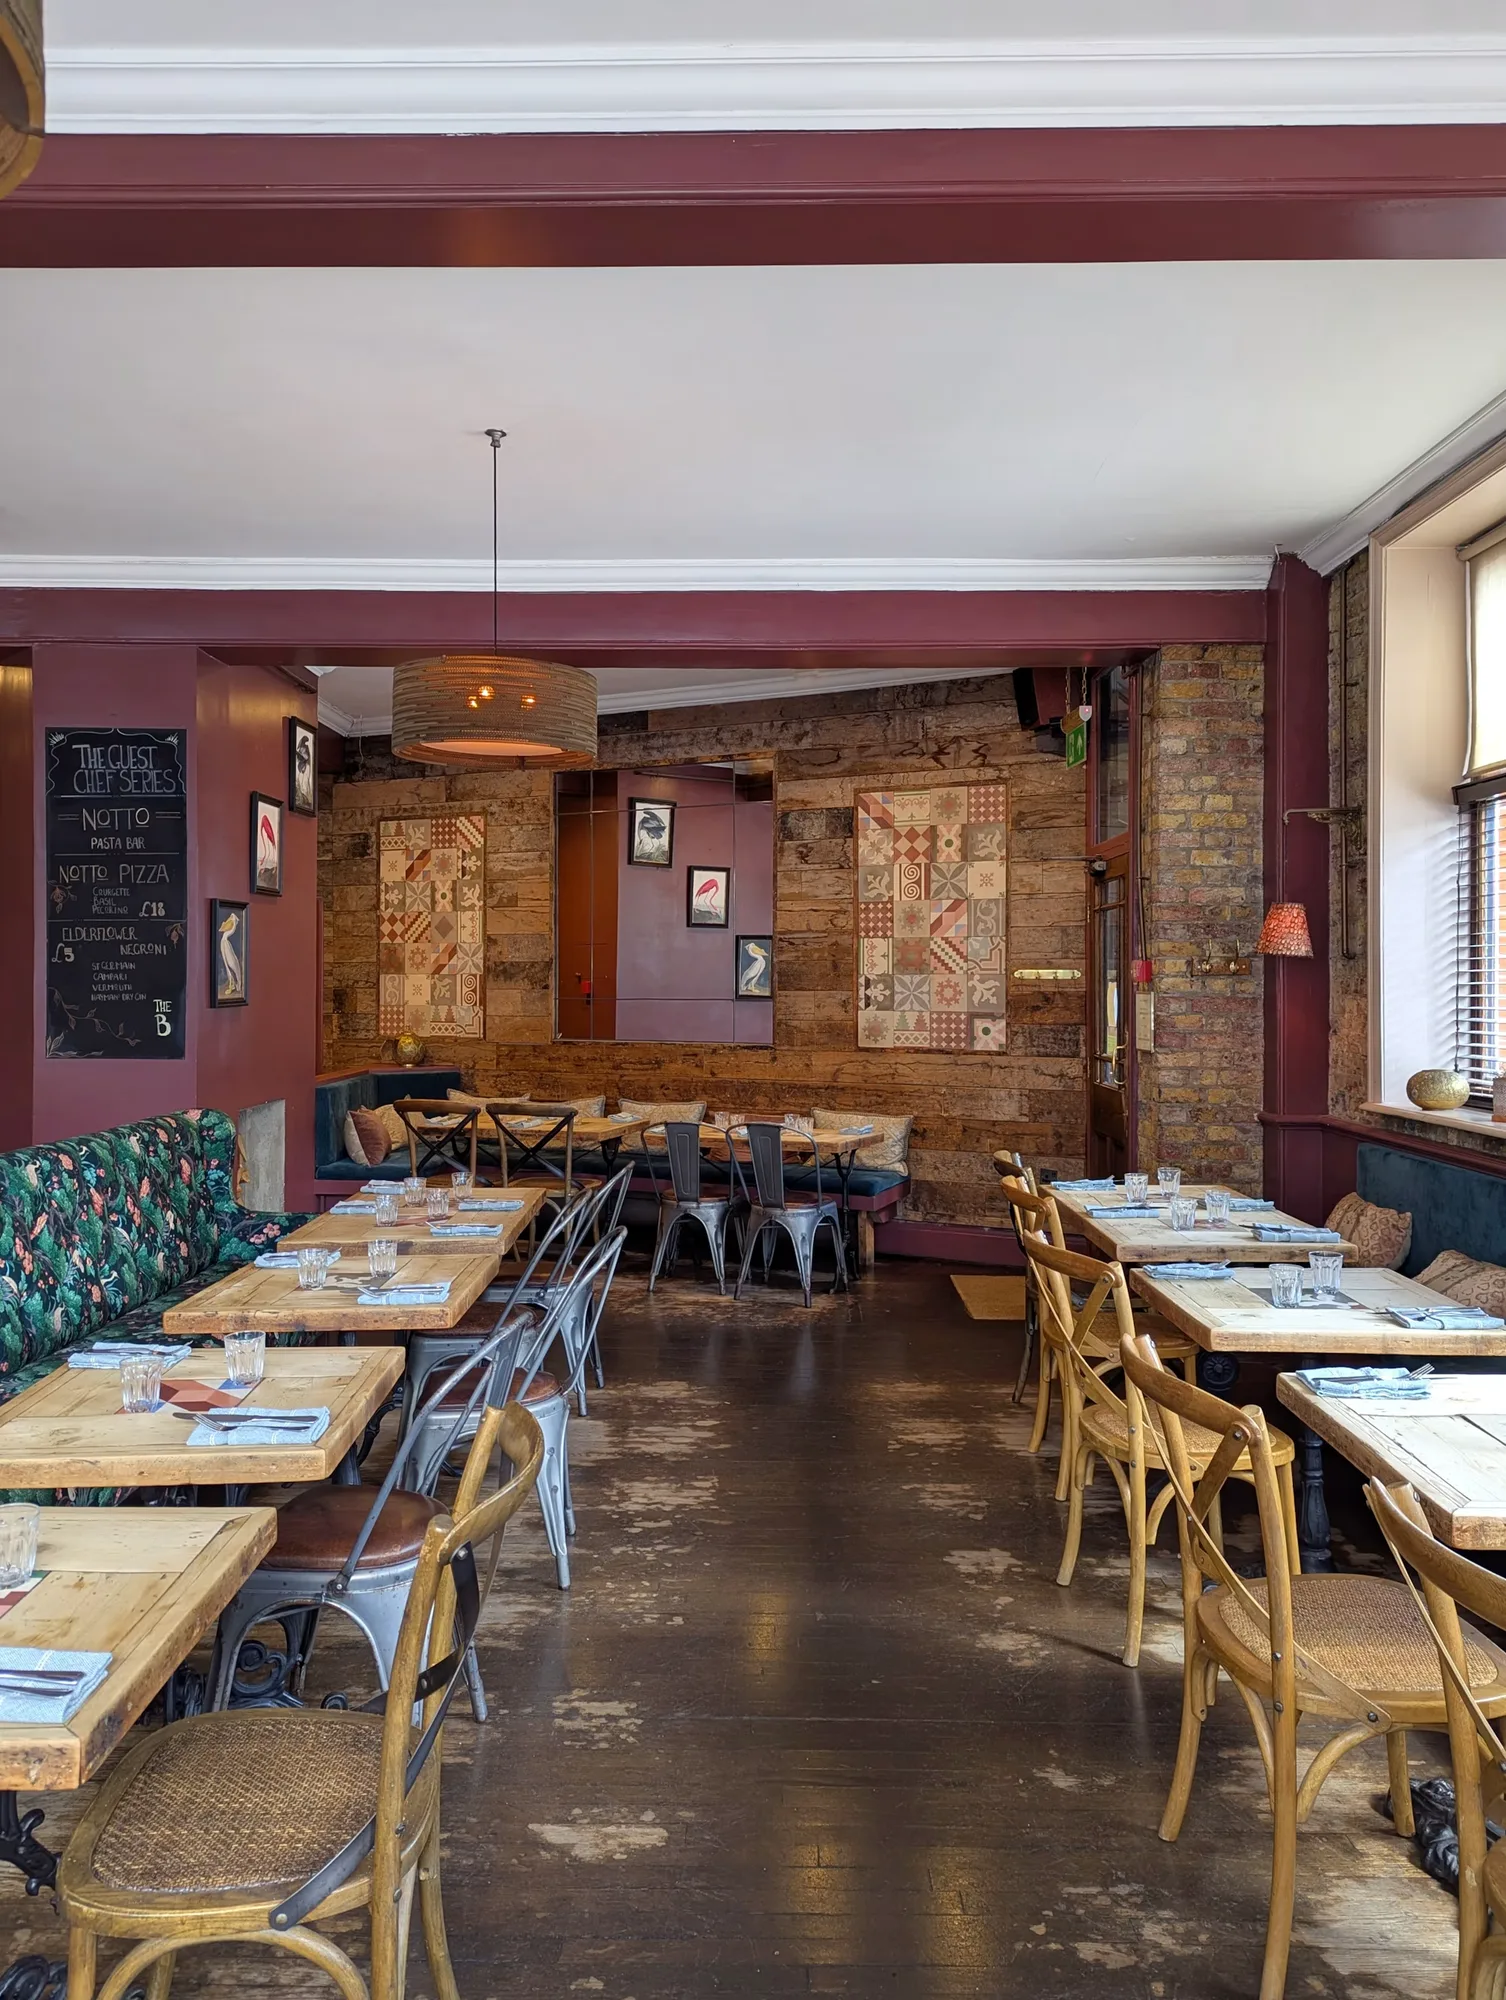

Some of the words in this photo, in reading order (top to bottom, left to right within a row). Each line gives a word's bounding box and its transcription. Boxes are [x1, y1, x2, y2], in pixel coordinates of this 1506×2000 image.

[72, 744, 106, 769] THE
[108, 744, 158, 769] GUEST
[73, 769, 116, 793] CHEF
[119, 769, 176, 793] SERIES
[82, 807, 150, 831] NOTTO
[91, 837, 122, 849] PASTA
[126, 837, 146, 849] BAR
[59, 865, 109, 883] NOTTO
[119, 863, 170, 884] PIZZA
[92, 887, 130, 896] COURGETTE
[93, 896, 116, 906] BASIL
[92, 905, 128, 914] PECORINO
[138, 901, 166, 917] £18
[62, 926, 138, 941] ELDERFLOWER
[51, 943, 75, 963] £5
[119, 943, 167, 956] NEGRONI
[91, 962, 100, 970] ST
[101, 961, 136, 970] GERMAIN
[93, 972, 128, 980] CAMPARI
[92, 983, 132, 991] VERMOUTH
[153, 999, 172, 1012] THE
[154, 1013, 172, 1037] B
